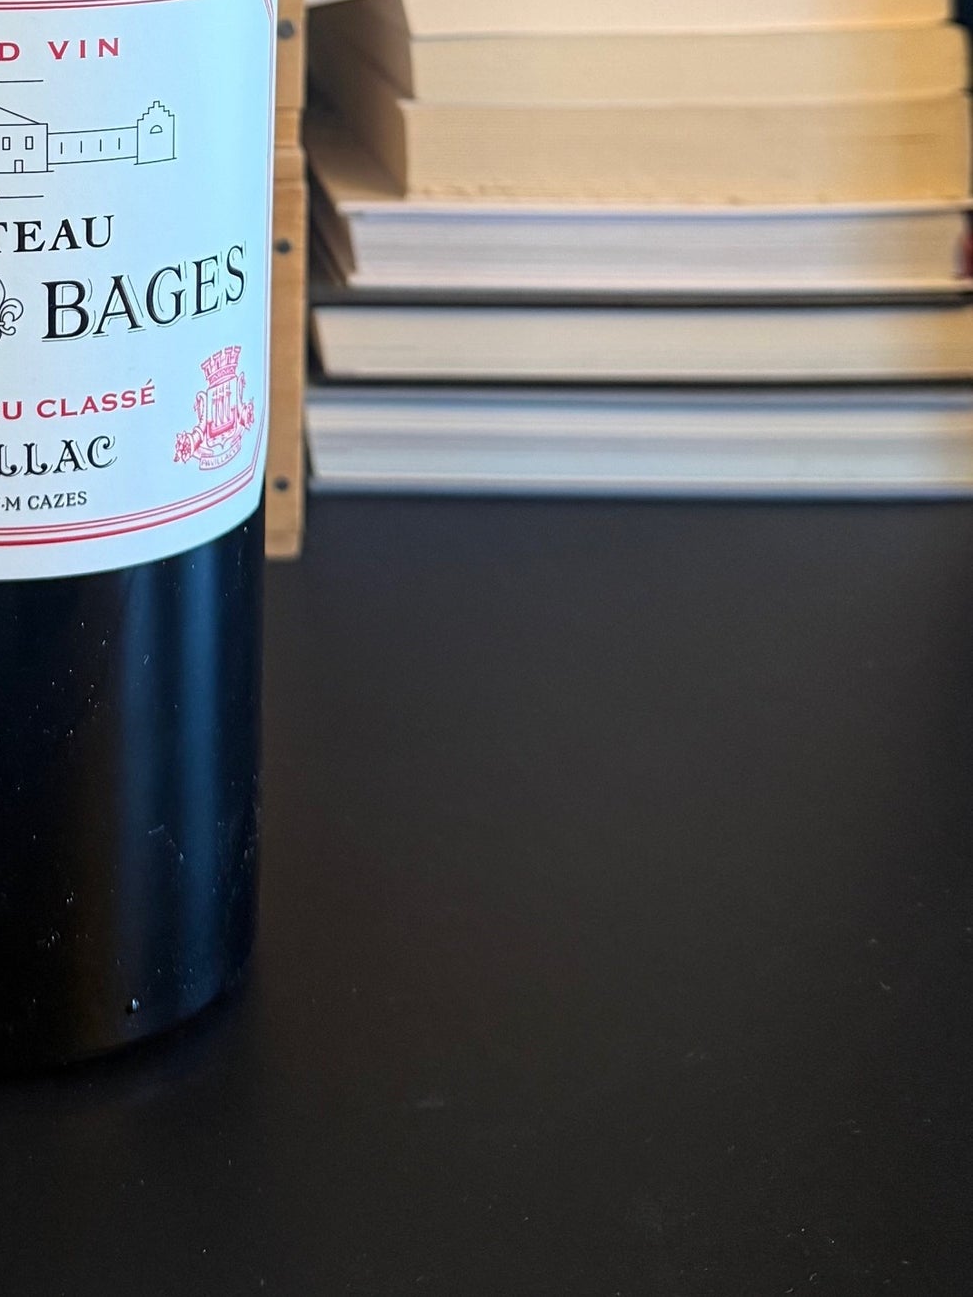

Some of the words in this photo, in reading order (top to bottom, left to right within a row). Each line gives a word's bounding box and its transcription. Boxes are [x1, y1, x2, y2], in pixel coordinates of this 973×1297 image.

[47, 37, 119, 60] VIN
[41, 240, 246, 343] BAGES
[36, 378, 156, 418] CLASSÉ
[26, 491, 88, 510] CAZES
